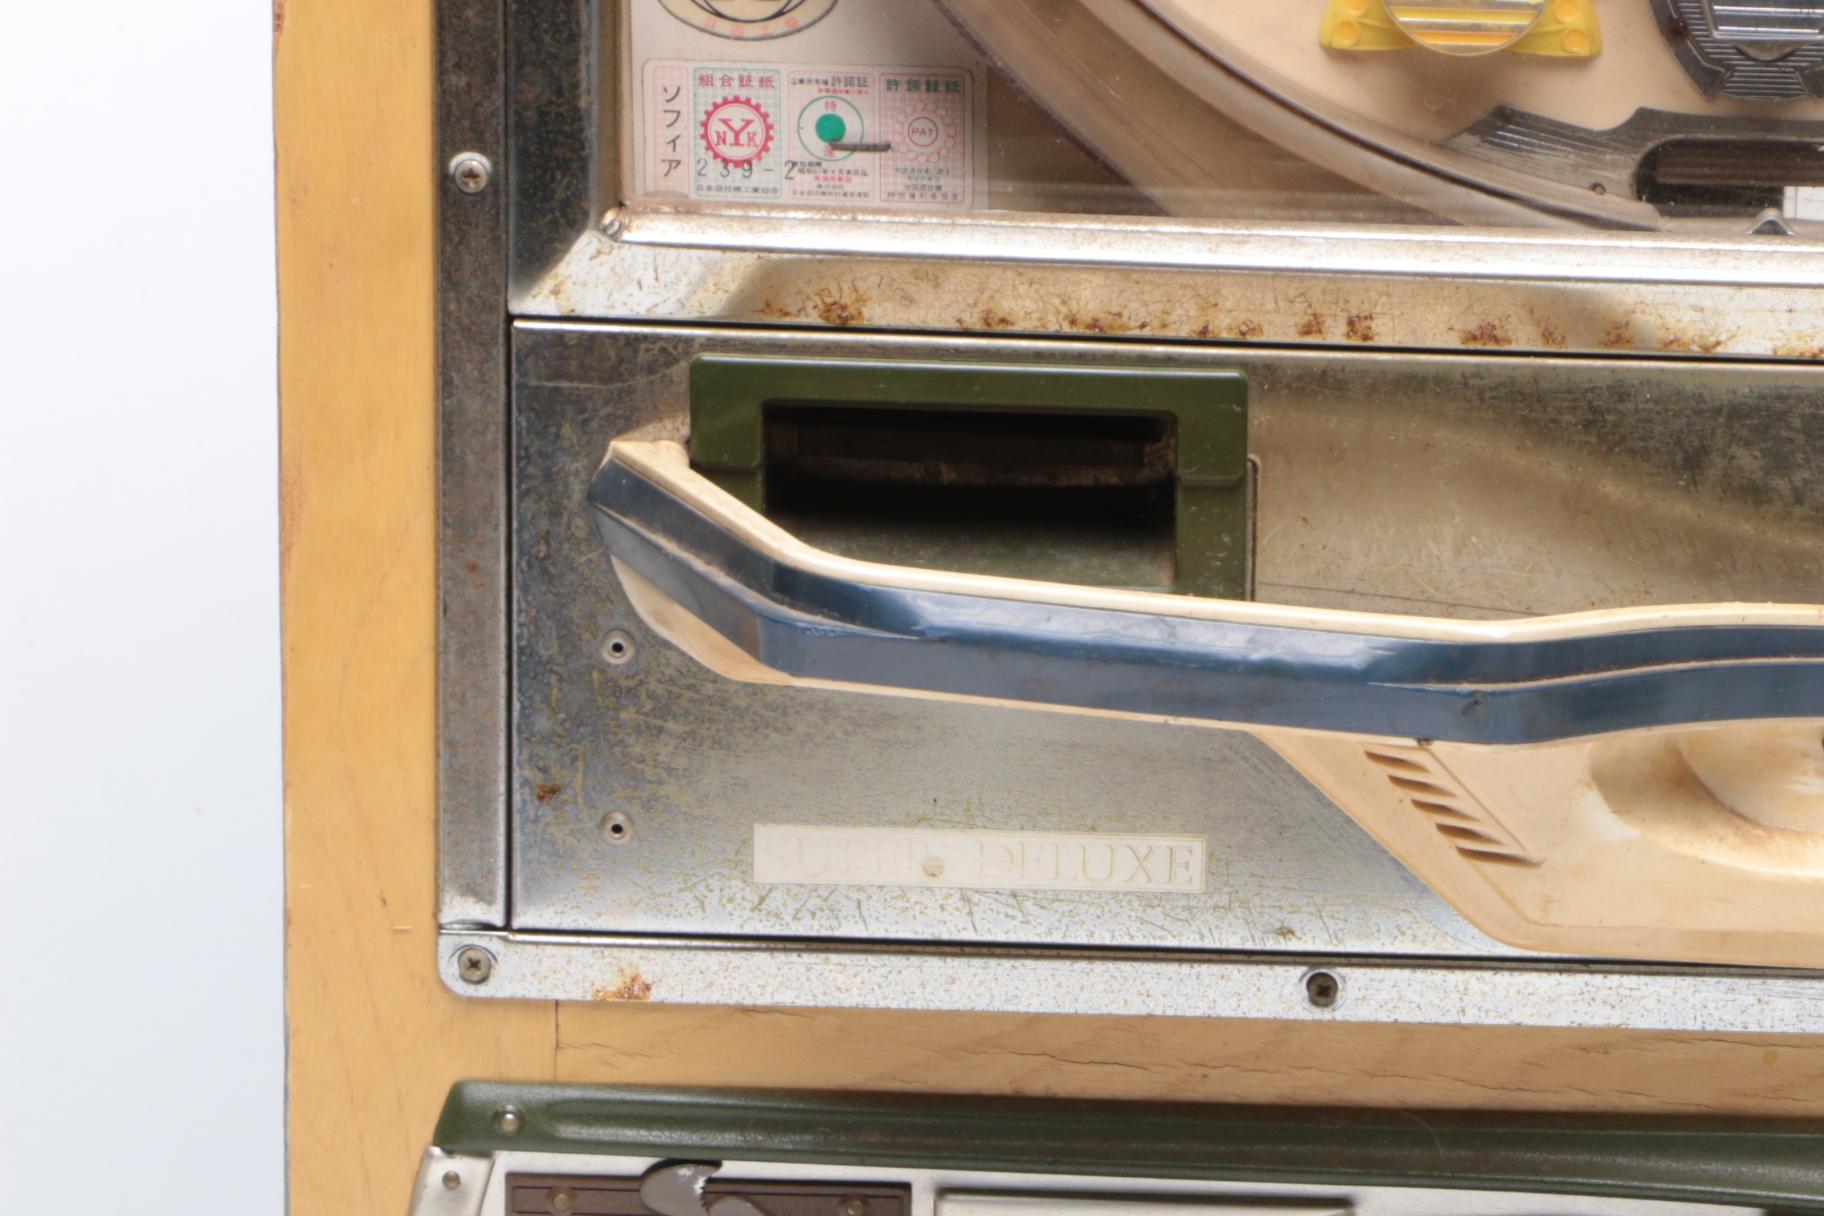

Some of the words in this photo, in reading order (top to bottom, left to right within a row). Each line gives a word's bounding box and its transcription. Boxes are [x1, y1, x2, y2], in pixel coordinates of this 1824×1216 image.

[698, 73, 775, 89] 組合証紙
[662, 85, 682, 178] ソフィア
[977, 839, 1195, 886] DELUXE
